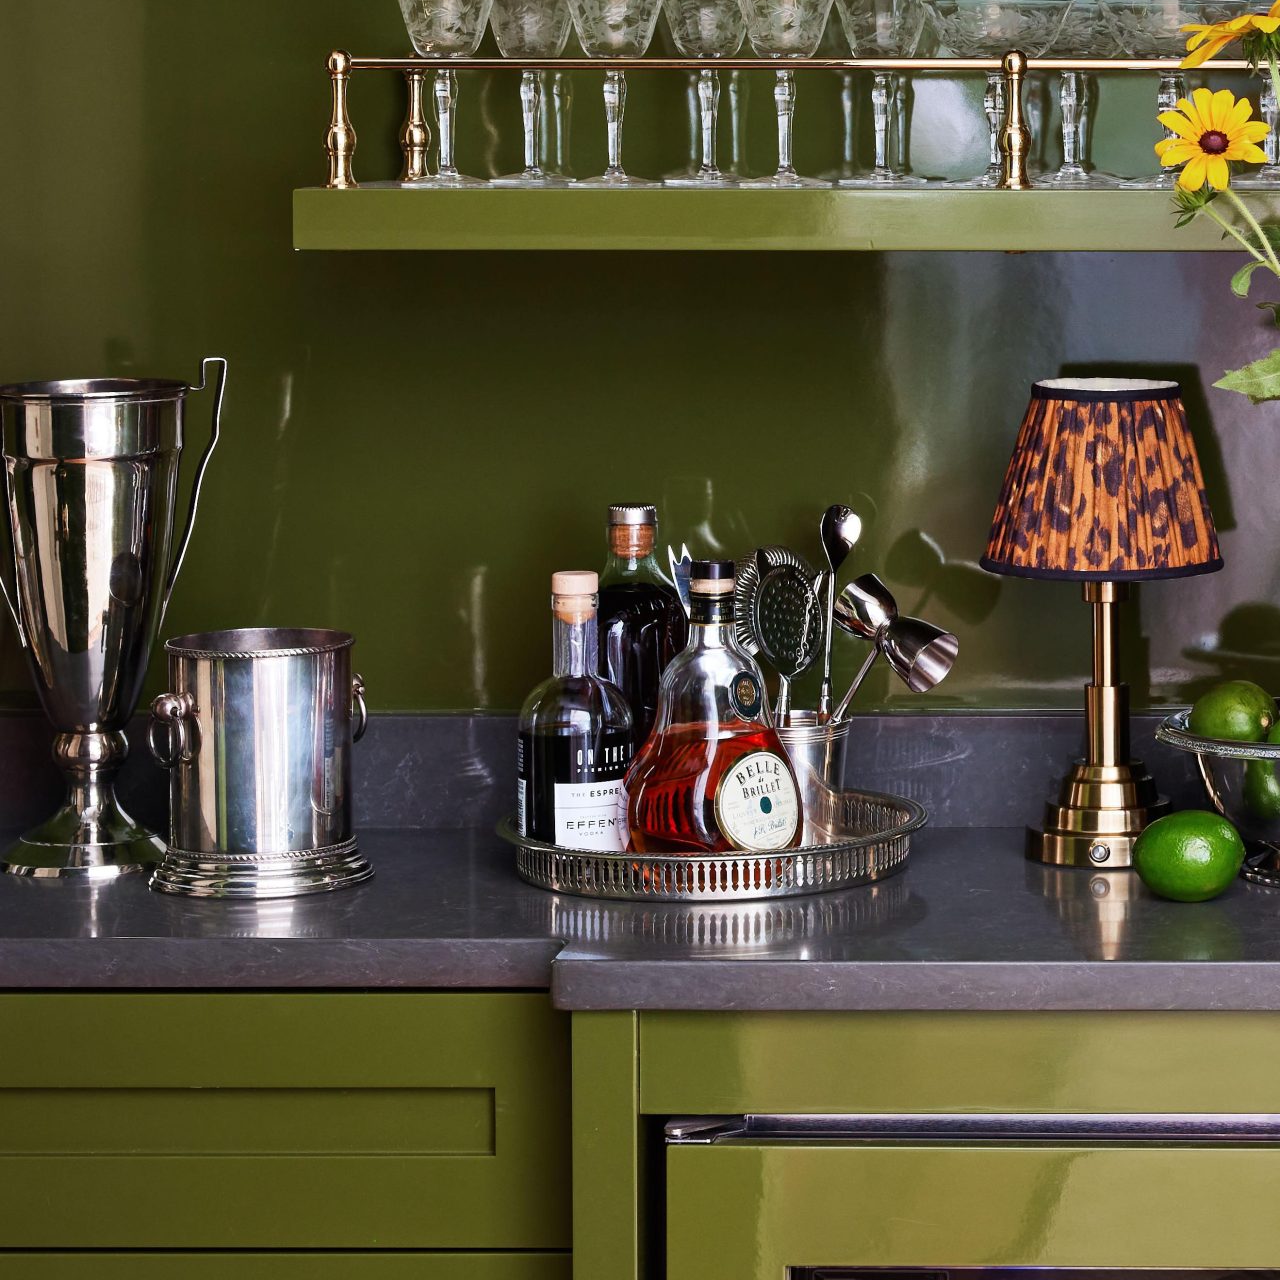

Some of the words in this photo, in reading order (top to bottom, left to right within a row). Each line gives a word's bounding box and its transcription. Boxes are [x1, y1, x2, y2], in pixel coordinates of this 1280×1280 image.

[577, 749, 594, 766] ON
[604, 745, 625, 764] THE
[736, 761, 779, 786] BELLE
[590, 787, 621, 798] ESPRE
[743, 779, 780, 799] BRILLET
[566, 819, 615, 830] EFFEN
